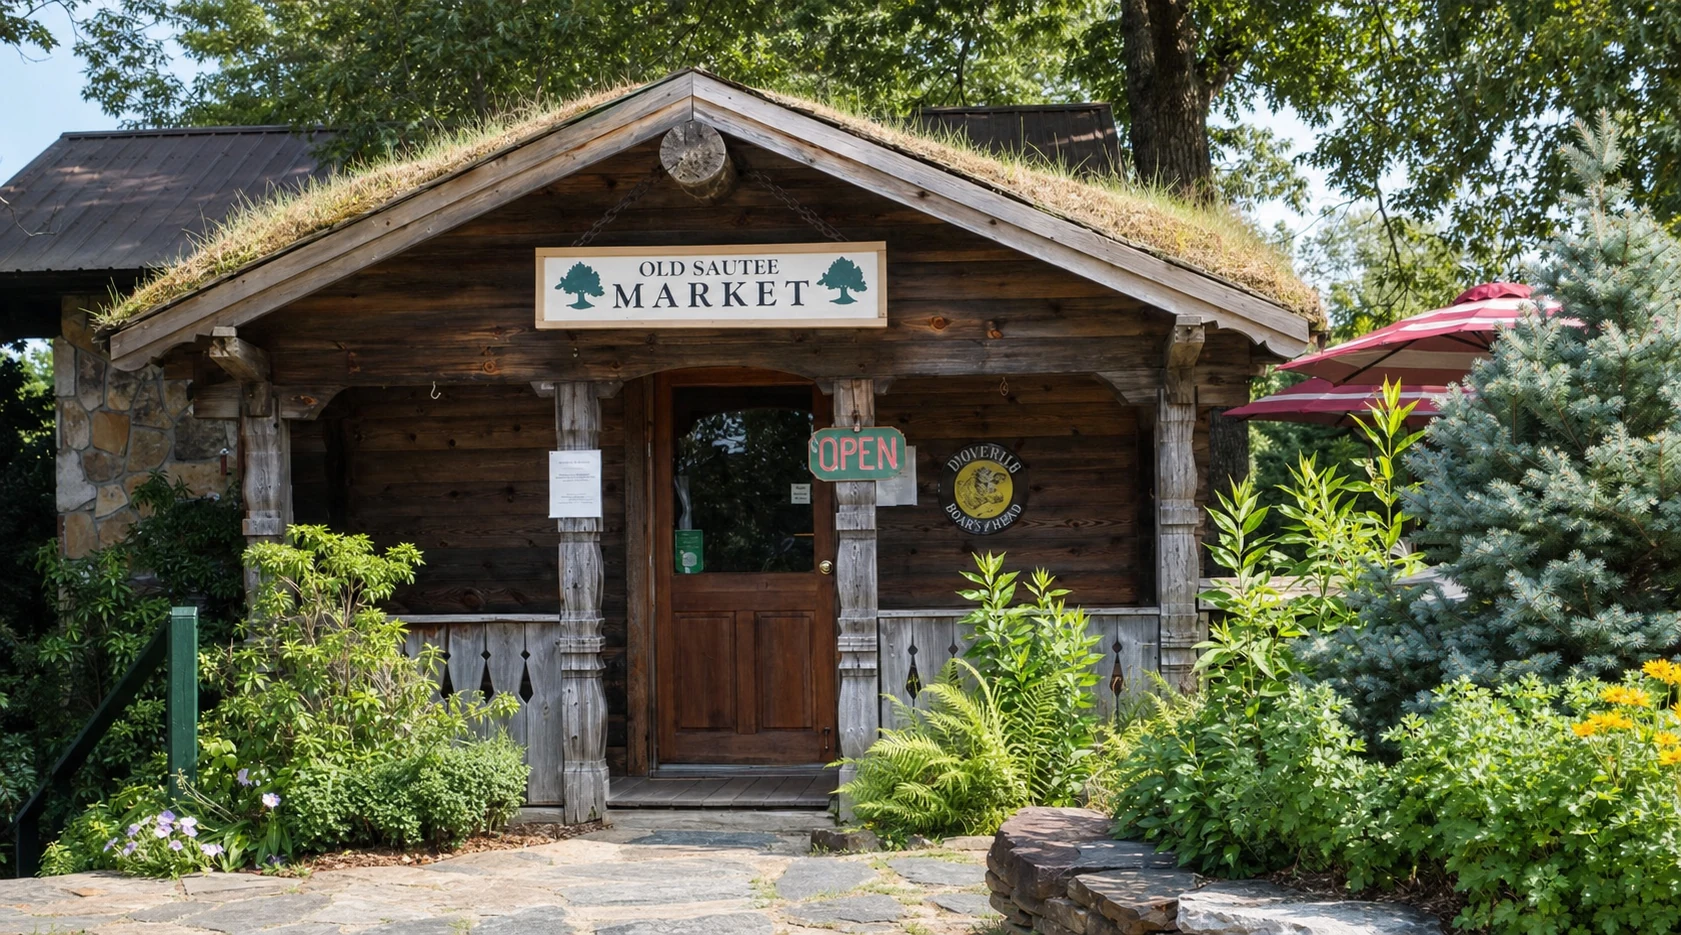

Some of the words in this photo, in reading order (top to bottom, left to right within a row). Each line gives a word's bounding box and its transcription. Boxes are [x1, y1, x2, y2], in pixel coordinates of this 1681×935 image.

[639, 261, 685, 277] OLD
[693, 259, 780, 276] SAUTEE
[612, 280, 810, 309] MARKET
[819, 436, 897, 472] OPEN
